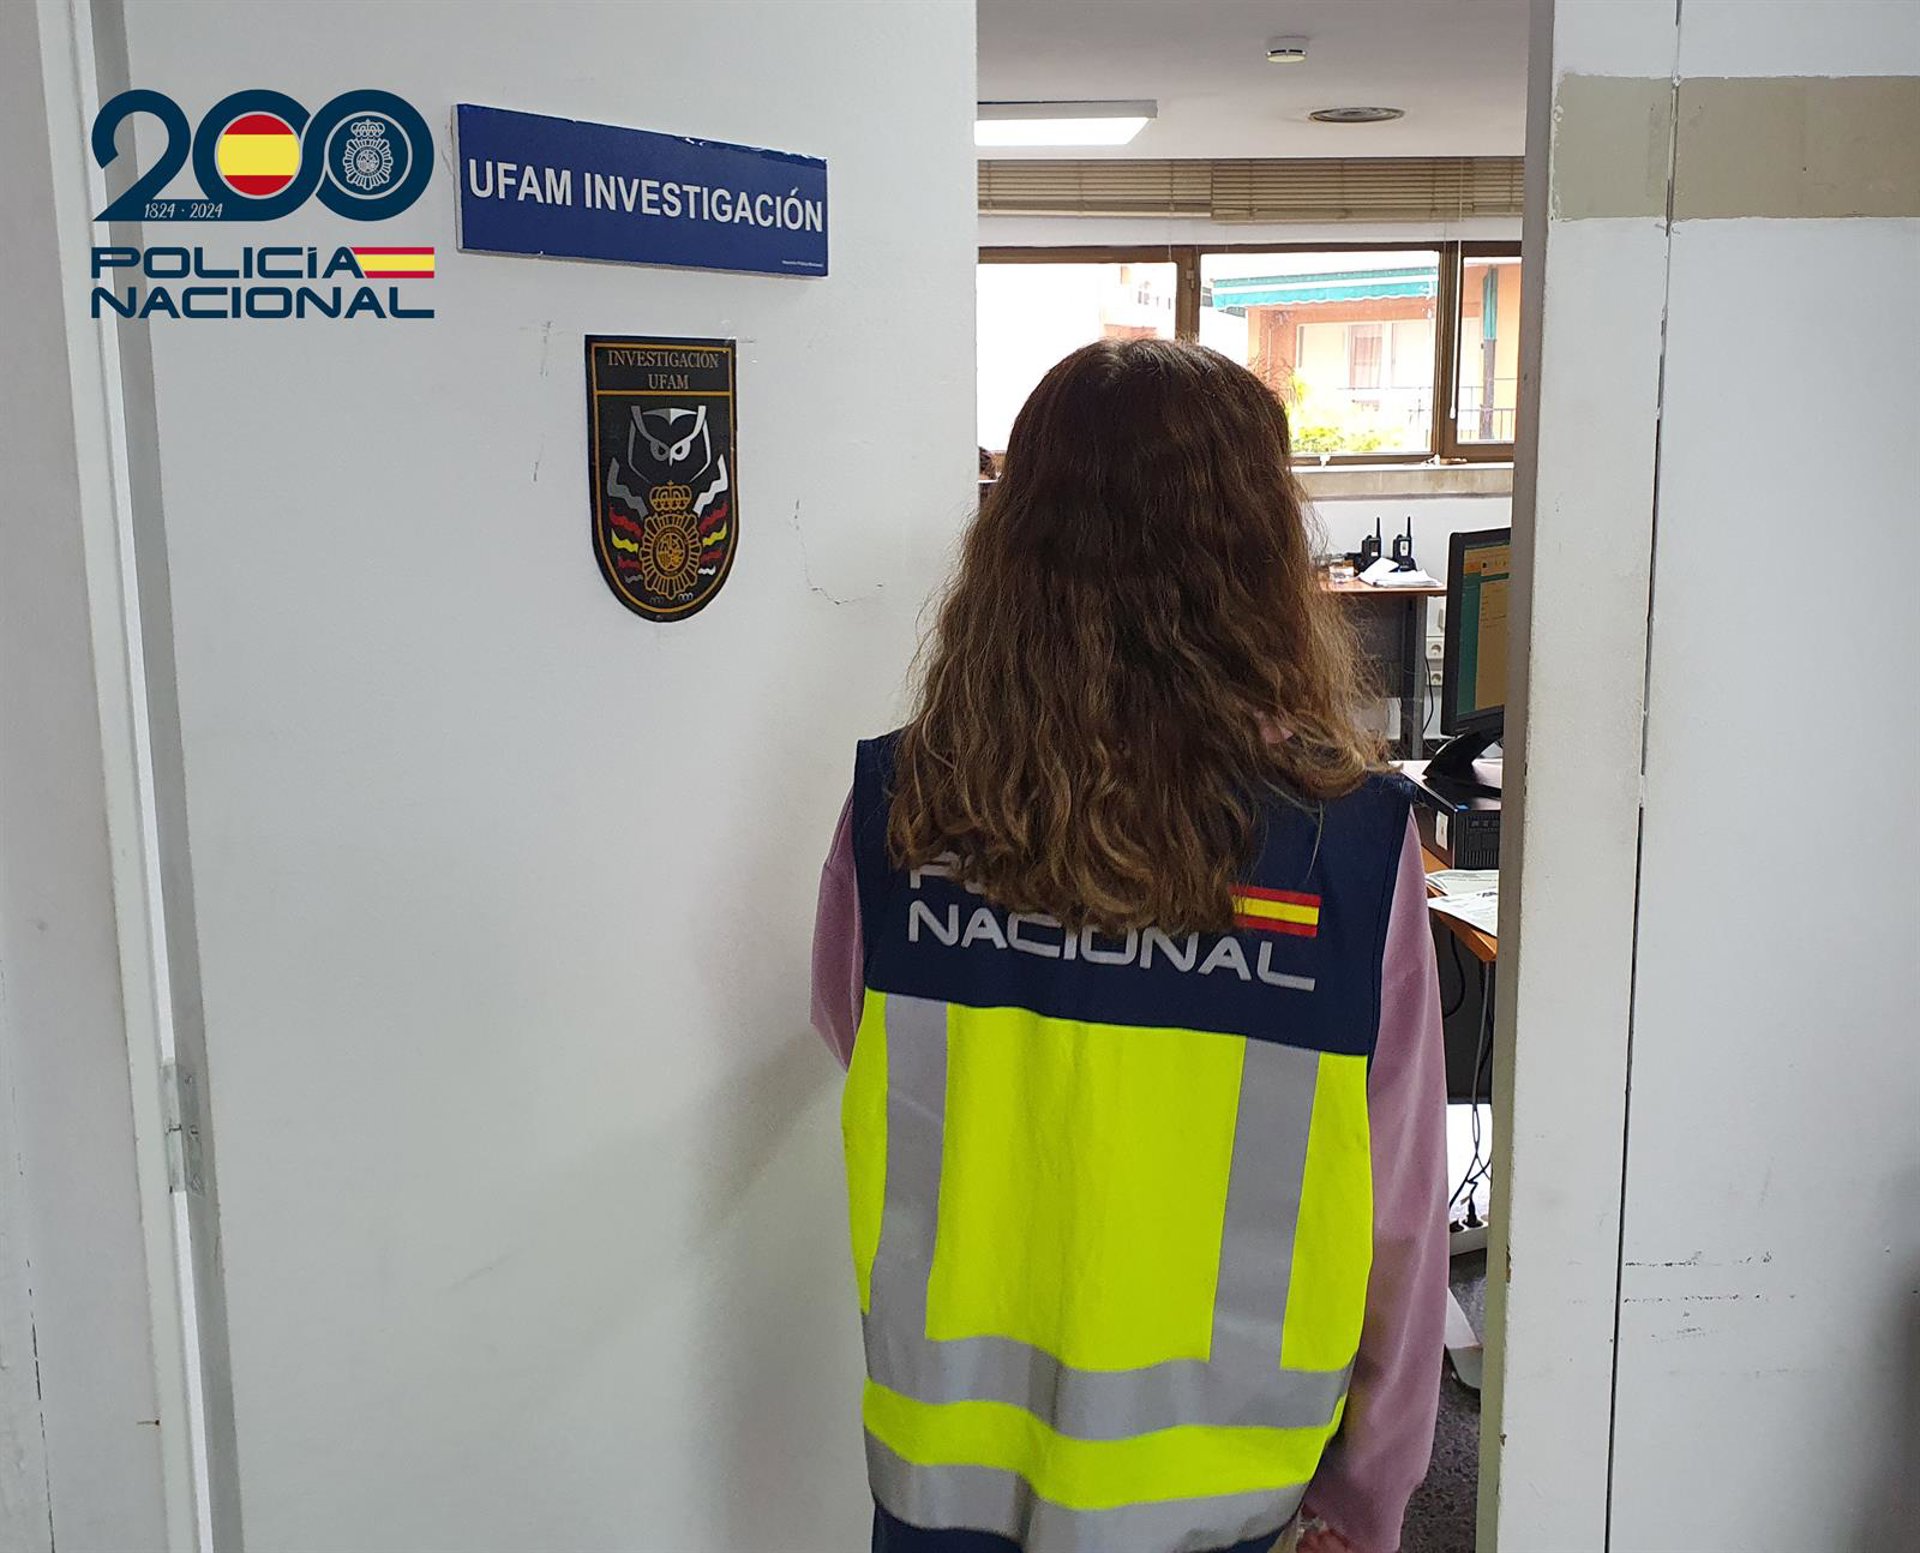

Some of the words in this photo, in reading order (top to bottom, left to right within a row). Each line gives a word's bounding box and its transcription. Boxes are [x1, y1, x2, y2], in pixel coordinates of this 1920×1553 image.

[468, 158, 571, 206] UFAM
[584, 172, 823, 232] INVESTIGACIÓN
[648, 374, 688, 389] UFAM
[908, 899, 1316, 991] NACIONAL
